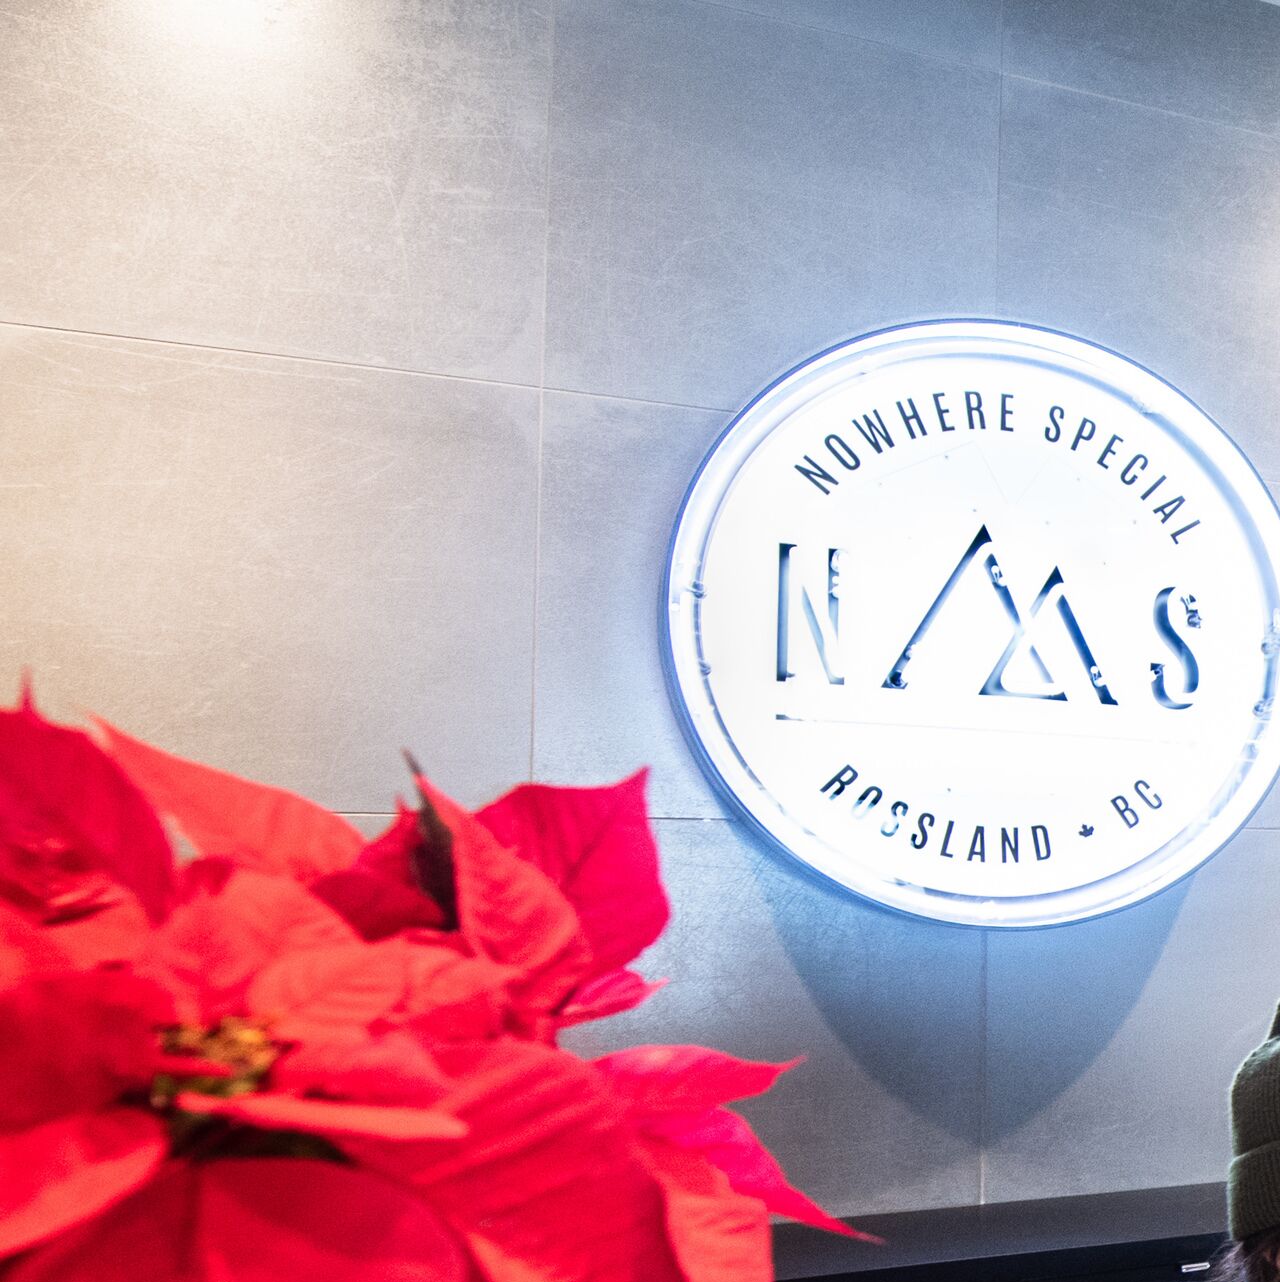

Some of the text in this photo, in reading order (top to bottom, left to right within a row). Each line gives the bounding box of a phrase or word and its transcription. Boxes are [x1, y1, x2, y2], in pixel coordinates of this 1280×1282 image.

[794, 391, 1202, 545] NOWHERE SPECIAL
[820, 764, 1163, 864] ROSSLAND BC
